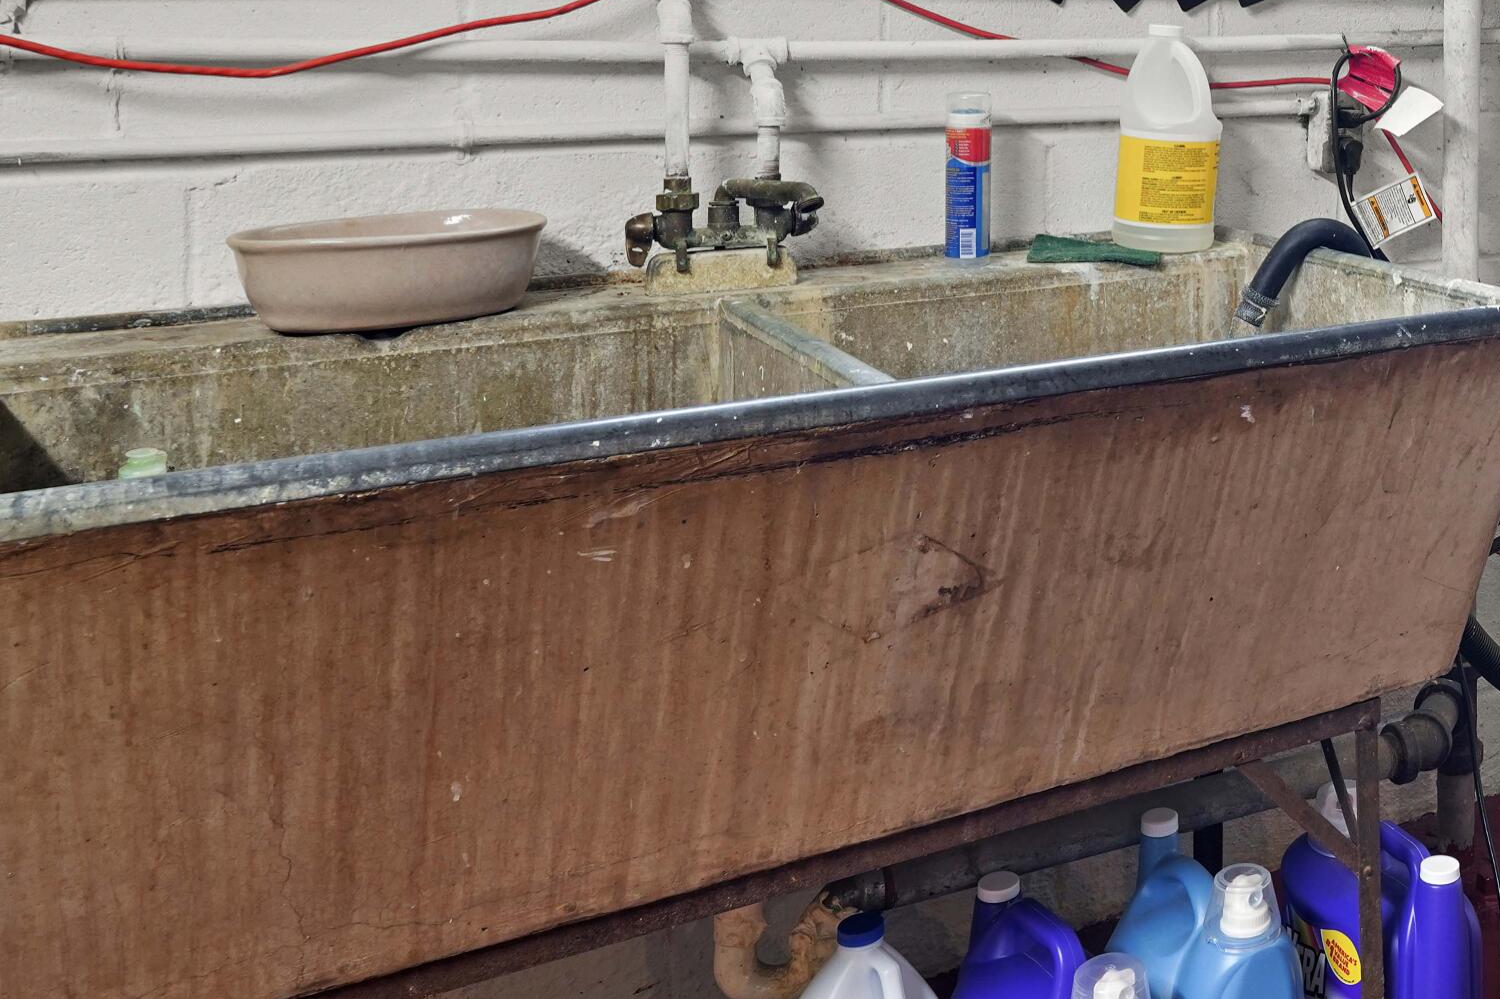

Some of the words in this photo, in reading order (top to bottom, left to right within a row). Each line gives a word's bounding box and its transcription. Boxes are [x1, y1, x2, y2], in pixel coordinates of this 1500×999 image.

[1331, 939, 1357, 966] AMERICA'S
[1334, 948, 1349, 968] VALUE
[1332, 955, 1350, 976] BRAND
